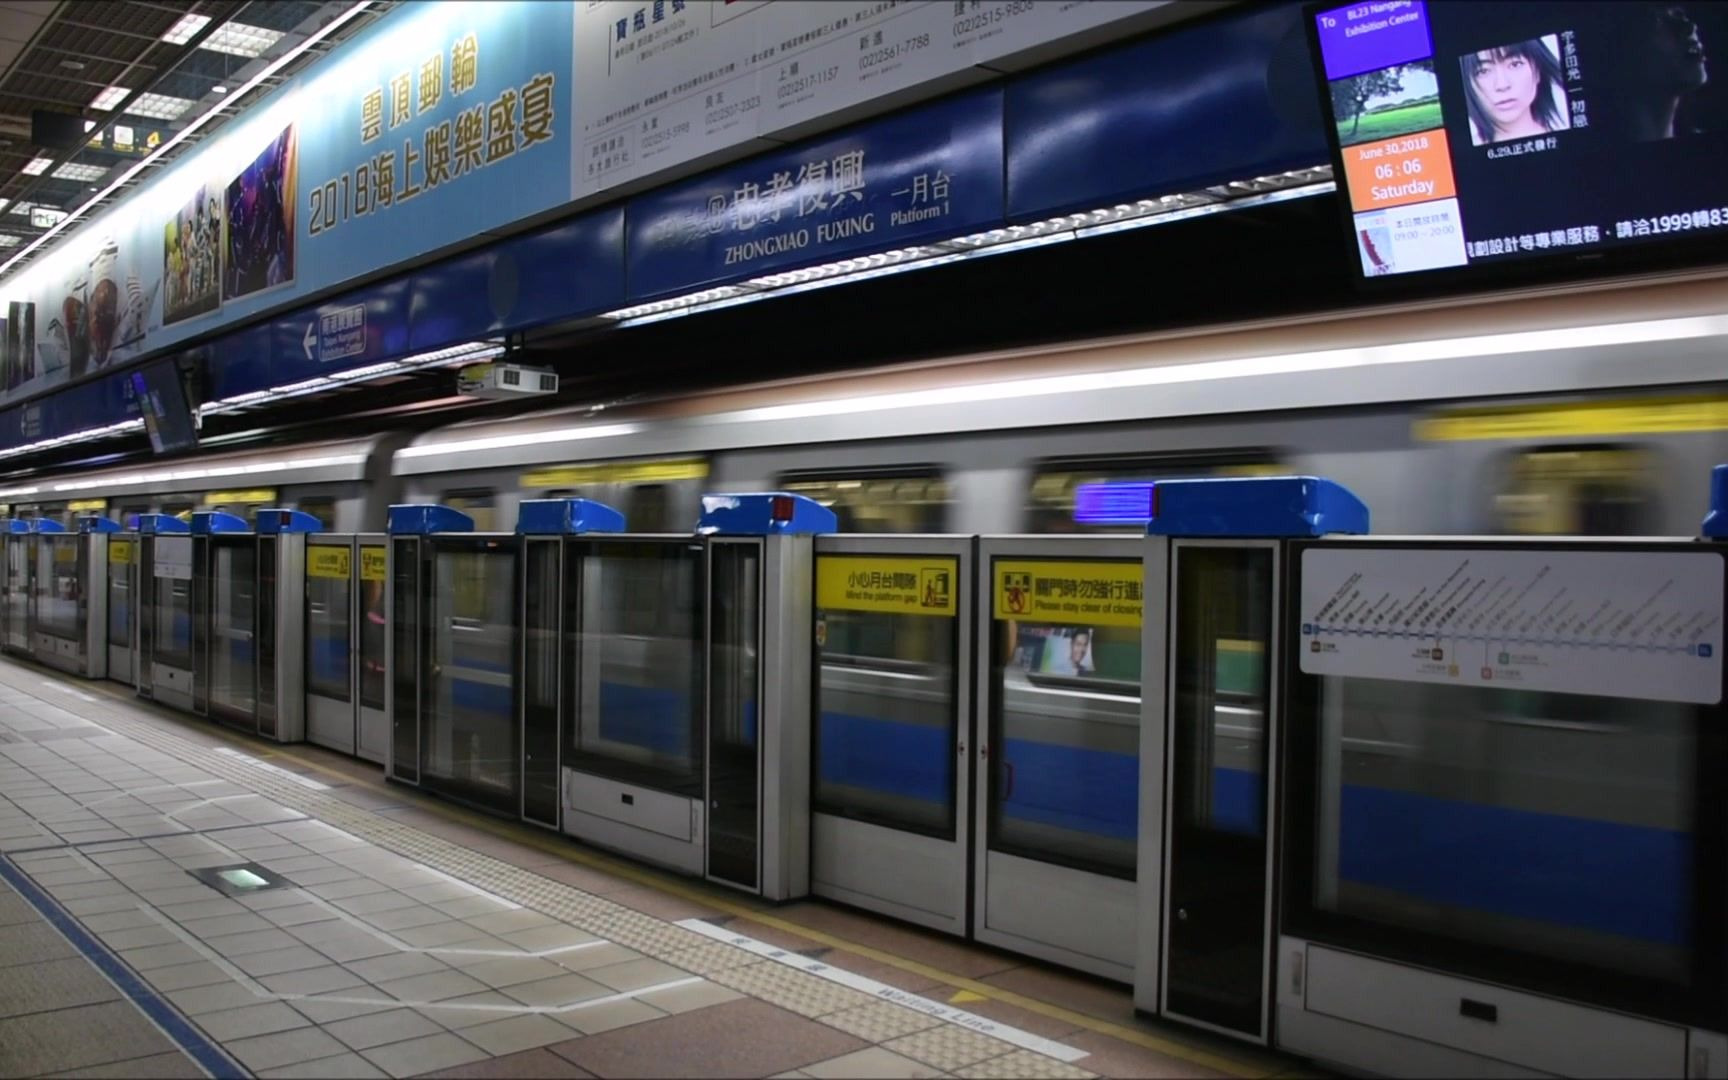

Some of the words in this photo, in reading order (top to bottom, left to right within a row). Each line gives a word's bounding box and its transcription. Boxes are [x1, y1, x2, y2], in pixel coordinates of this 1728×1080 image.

[1320, 17, 1337, 29] To
[1344, 20, 1388, 38] Exhibition
[1388, 12, 1419, 26] Center
[858, 33, 930, 72] (02)2561-7788
[1560, 30, 1581, 80] 宇多田光
[361, 33, 478, 144] 雲頂郵輪
[1360, 148, 1383, 161] June
[1375, 164, 1393, 179] 06
[1402, 159, 1422, 175] 06
[731, 150, 866, 232] 忠孝復興
[890, 169, 951, 205] 一月台
[1371, 180, 1434, 201] Saturday
[890, 204, 941, 227] Platform
[725, 228, 809, 265] ZHONGXIAO
[816, 213, 875, 244] FUXING
